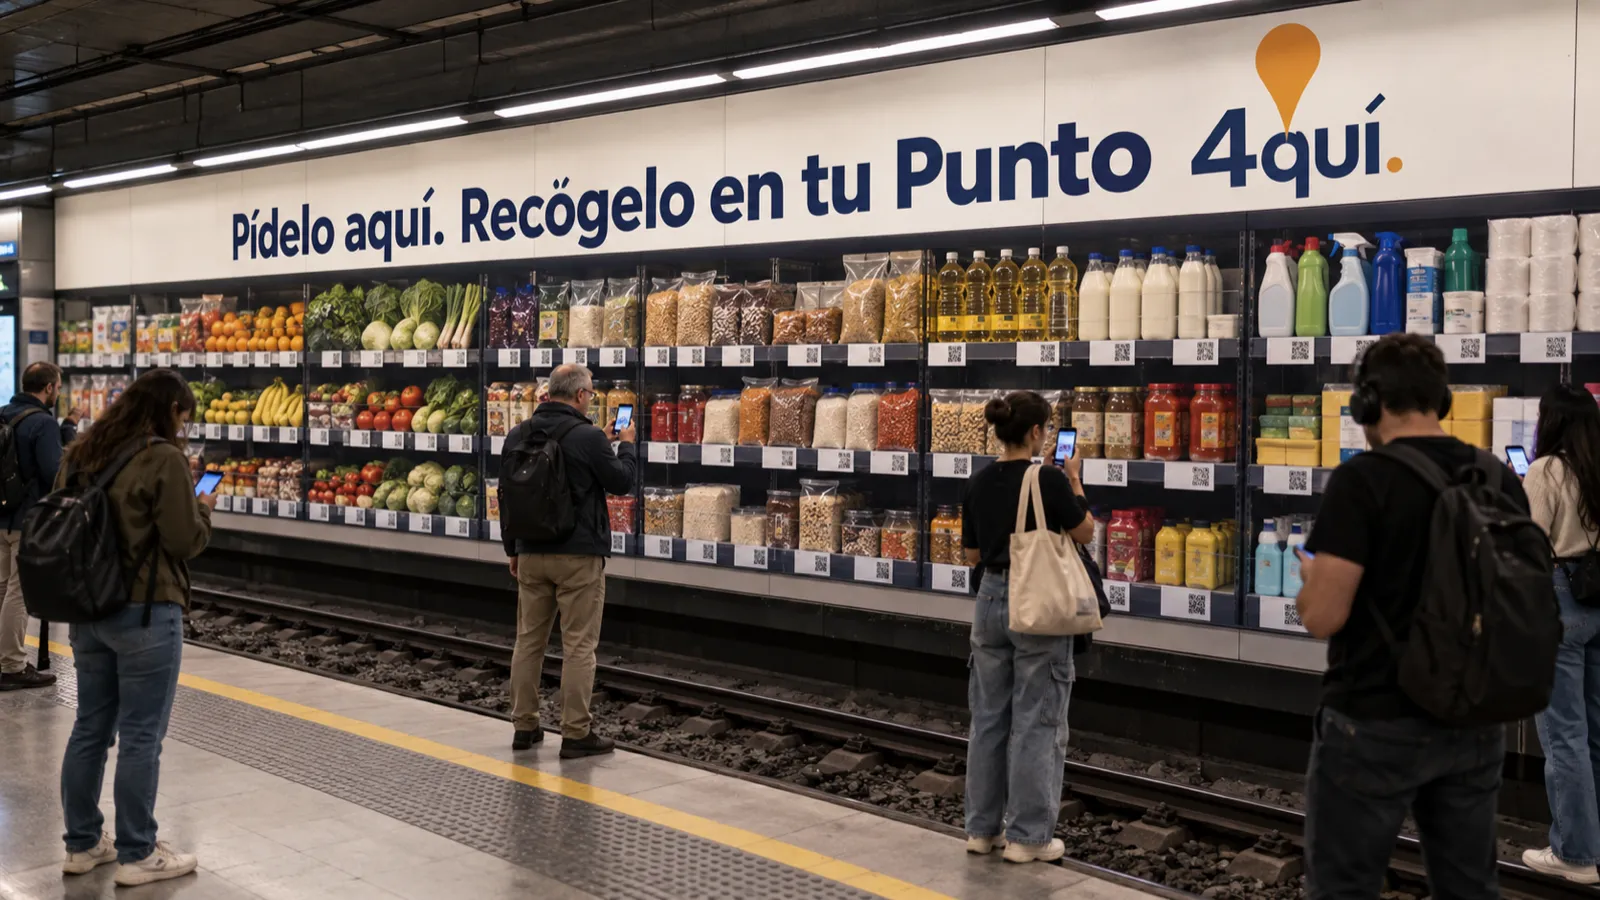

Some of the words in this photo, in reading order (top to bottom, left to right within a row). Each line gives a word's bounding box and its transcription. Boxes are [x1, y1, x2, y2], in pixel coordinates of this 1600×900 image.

[232, 203, 335, 261] Pídelo
[344, 186, 445, 263] aquí.
[710, 171, 784, 224] en
[801, 154, 871, 217] tu
[896, 121, 1152, 210] Punto
[1190, 92, 1403, 199] 4quí.
